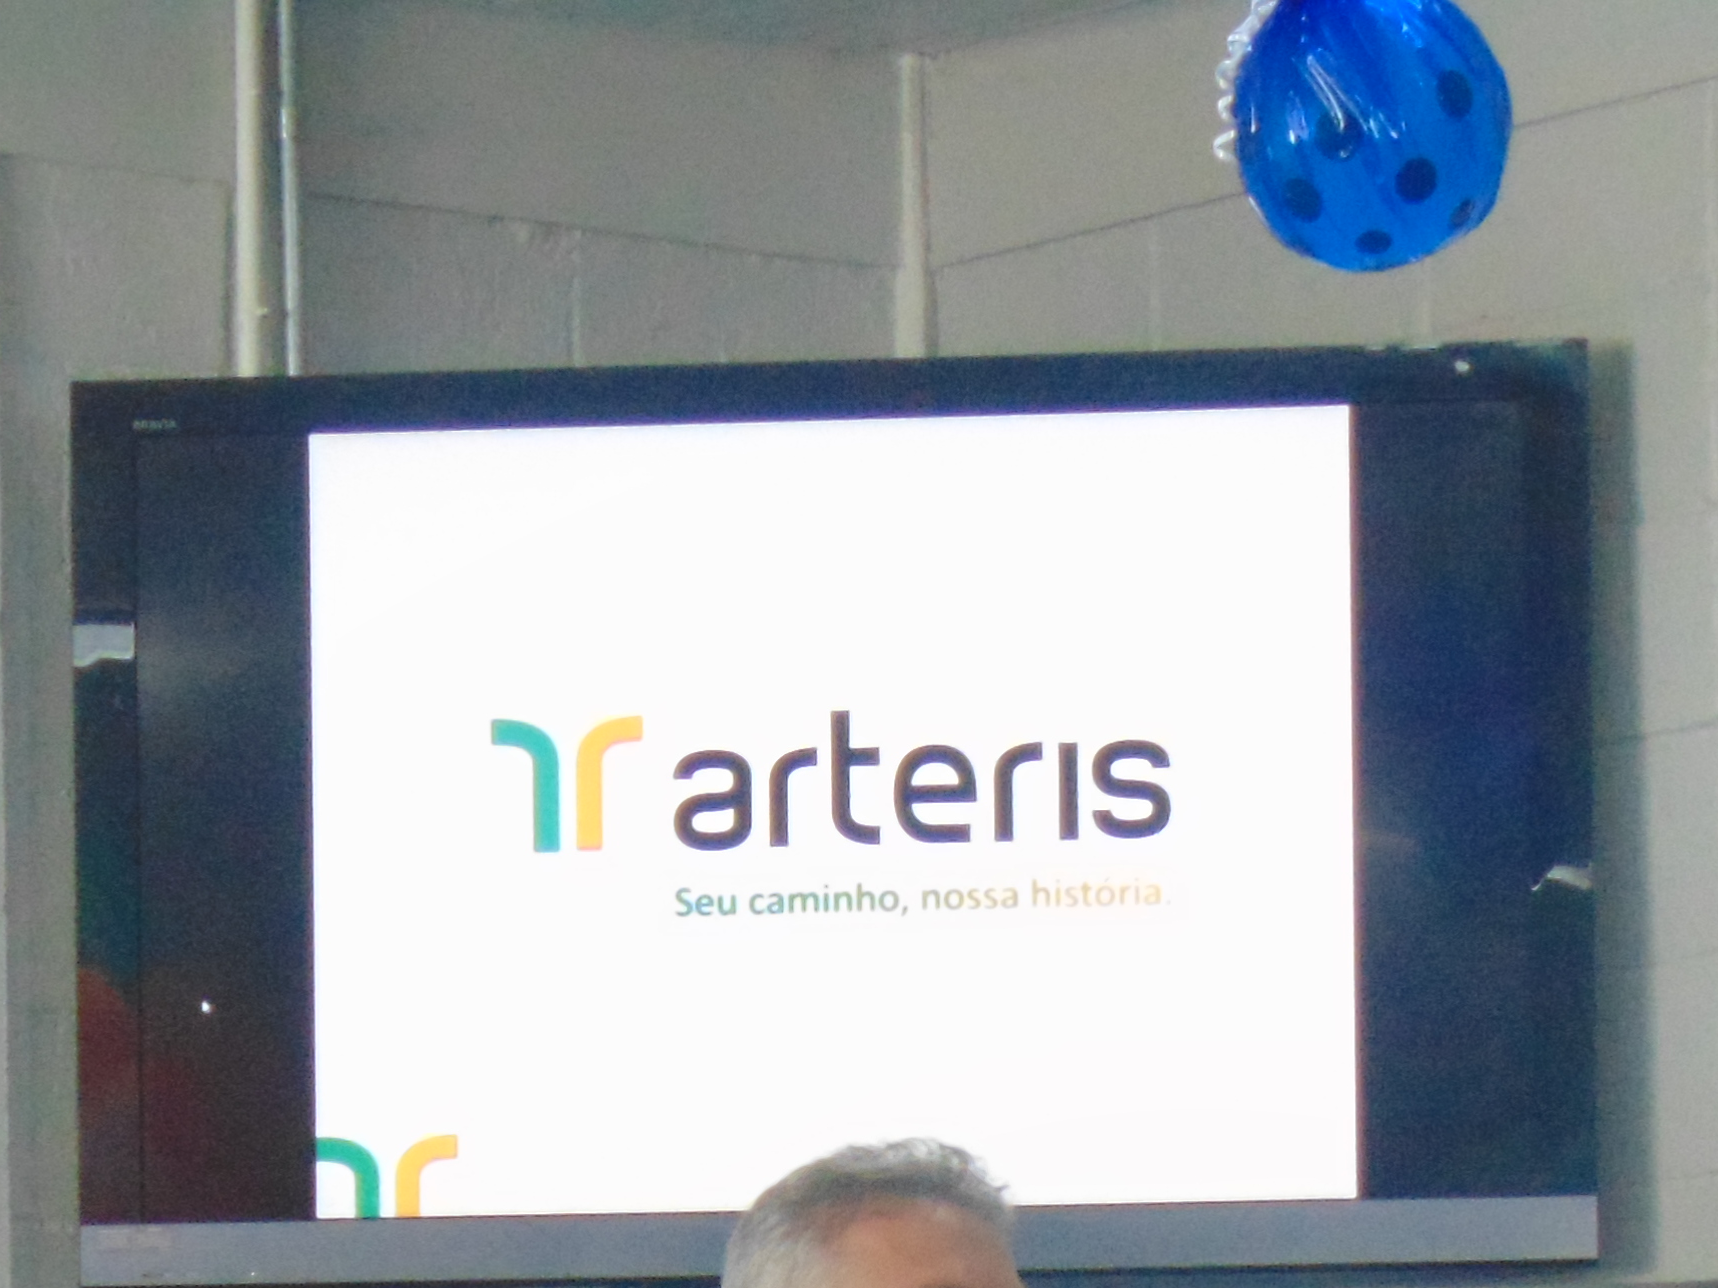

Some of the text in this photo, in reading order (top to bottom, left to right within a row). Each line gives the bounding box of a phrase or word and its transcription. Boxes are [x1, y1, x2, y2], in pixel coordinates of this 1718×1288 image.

[673, 710, 1172, 851] arteris
[675, 878, 1172, 916] Seu caminho, nossa história.
